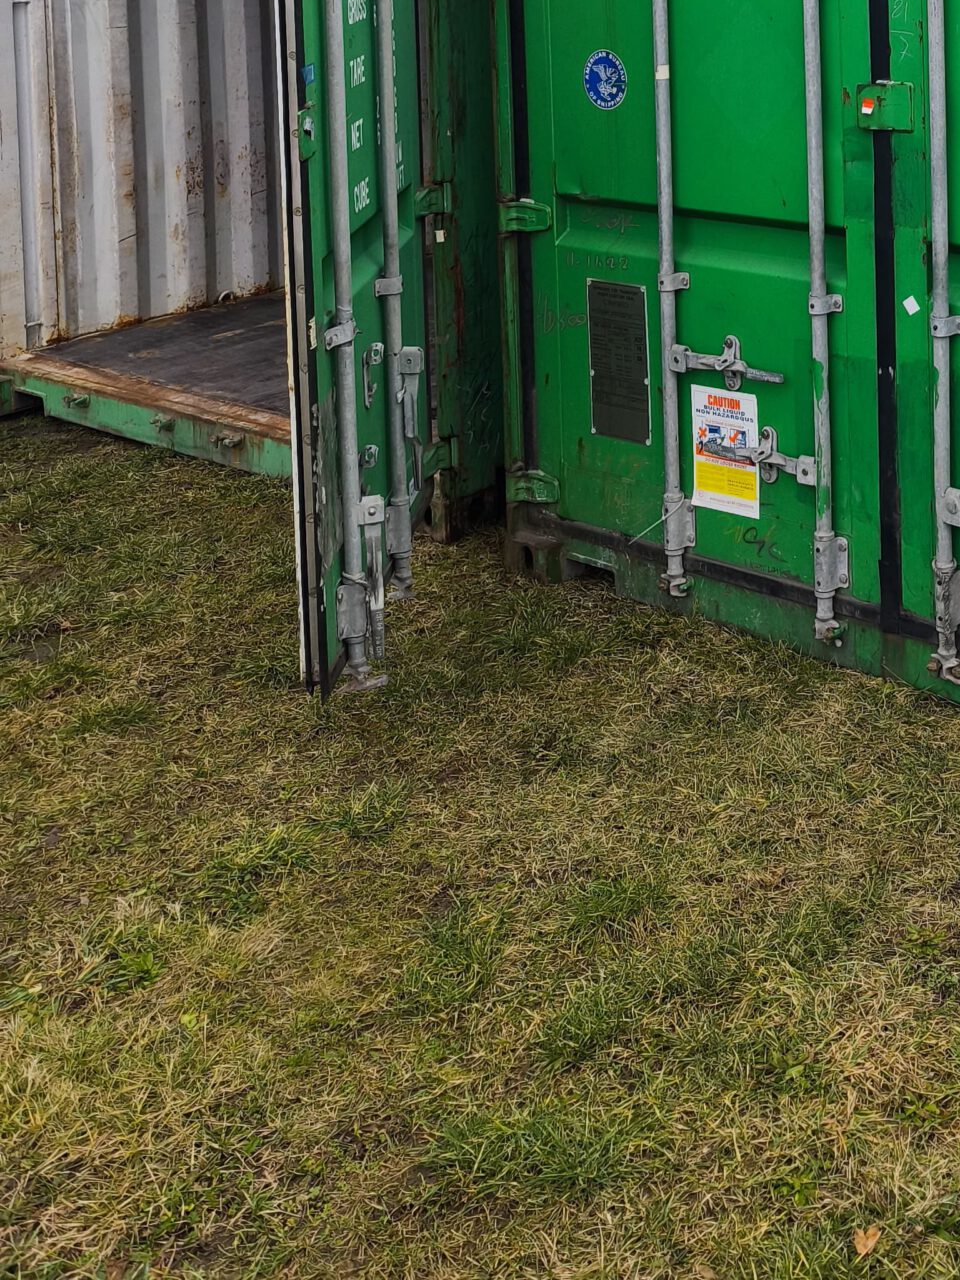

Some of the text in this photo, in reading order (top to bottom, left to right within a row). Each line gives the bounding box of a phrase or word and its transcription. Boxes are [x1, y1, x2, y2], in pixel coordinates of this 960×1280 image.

[349, 54, 366, 89] TARE
[585, 51, 626, 81] AMERICAN BUREAU
[597, 91, 623, 108] SHIPPING
[351, 117, 364, 151] NET
[353, 176, 370, 214] CUBE
[703, 404, 746, 417] BULK LIQUID
[707, 394, 741, 410] CAUTION
